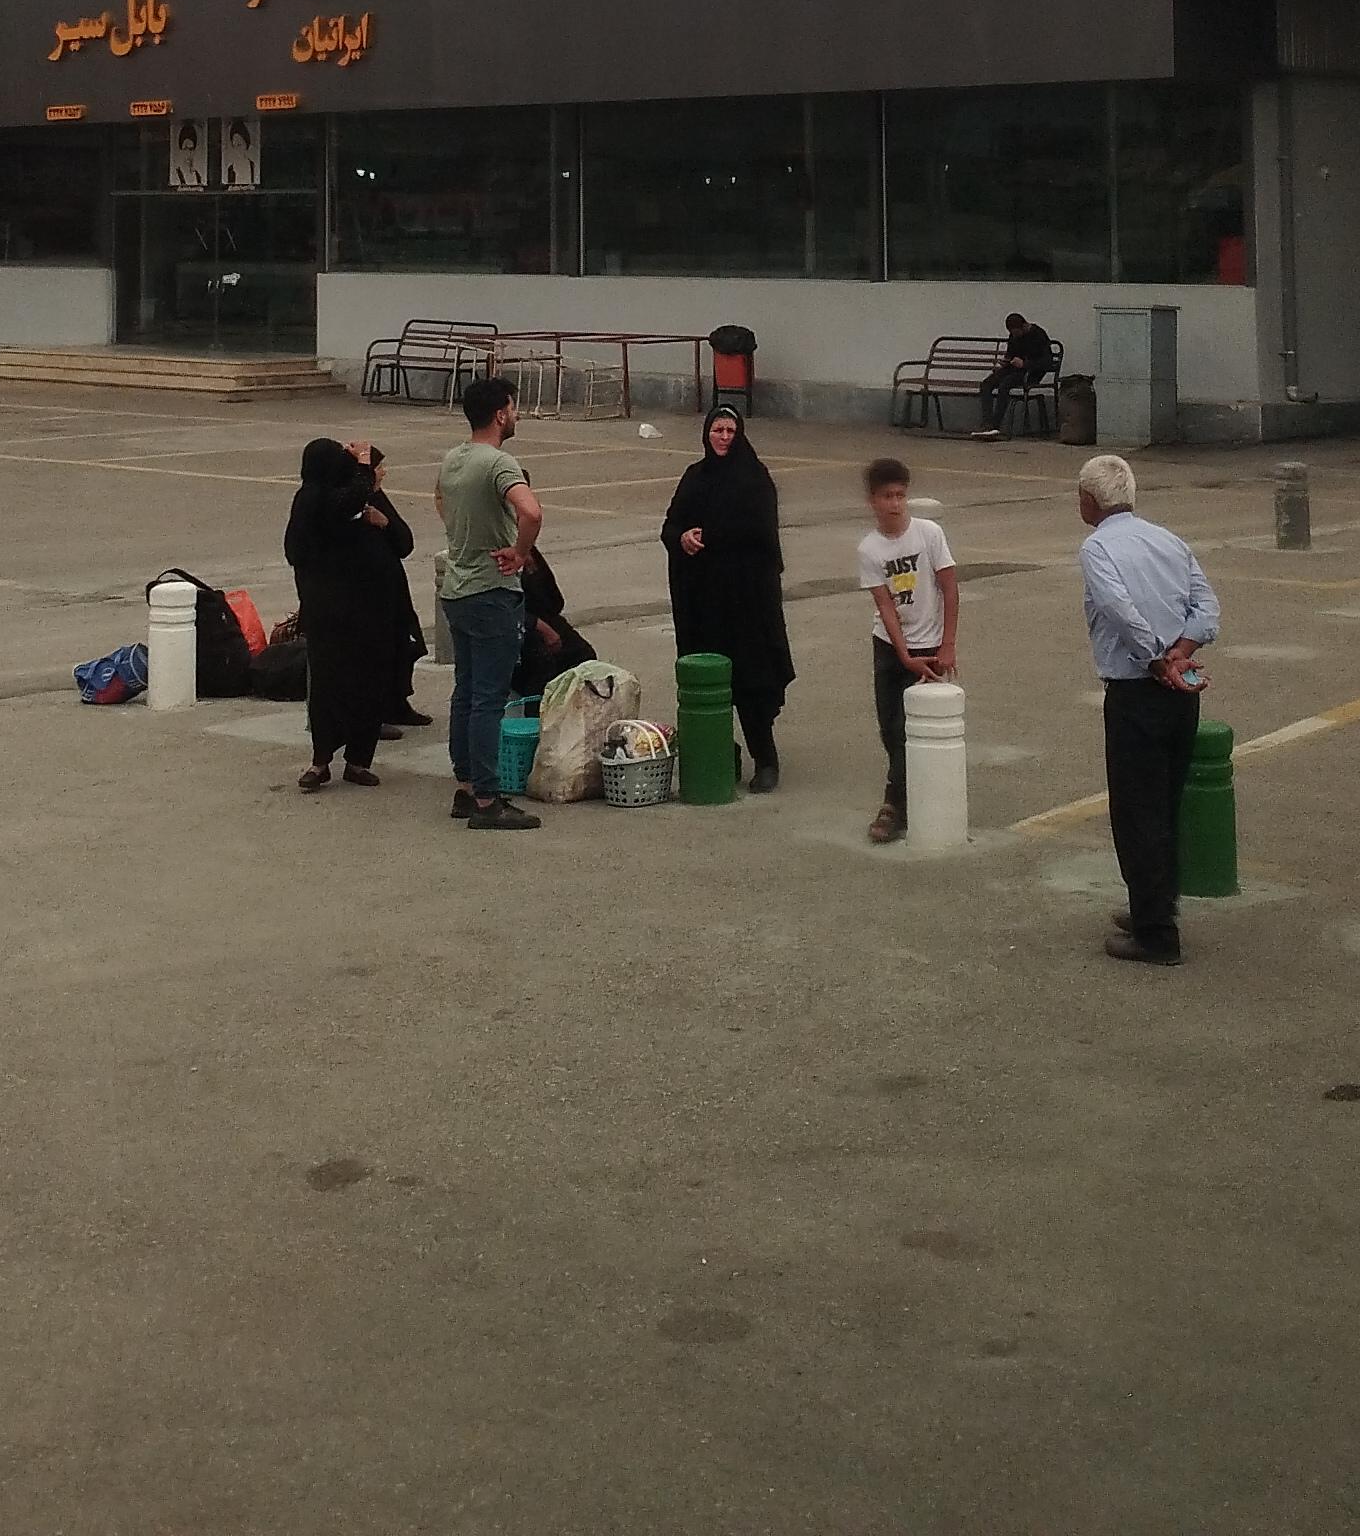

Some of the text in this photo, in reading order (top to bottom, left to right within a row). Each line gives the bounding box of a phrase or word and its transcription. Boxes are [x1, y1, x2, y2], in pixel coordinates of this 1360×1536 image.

[48, 12, 106, 61] سیر
[292, 12, 369, 66] ایرانیان
[884, 552, 921, 579] JUST
